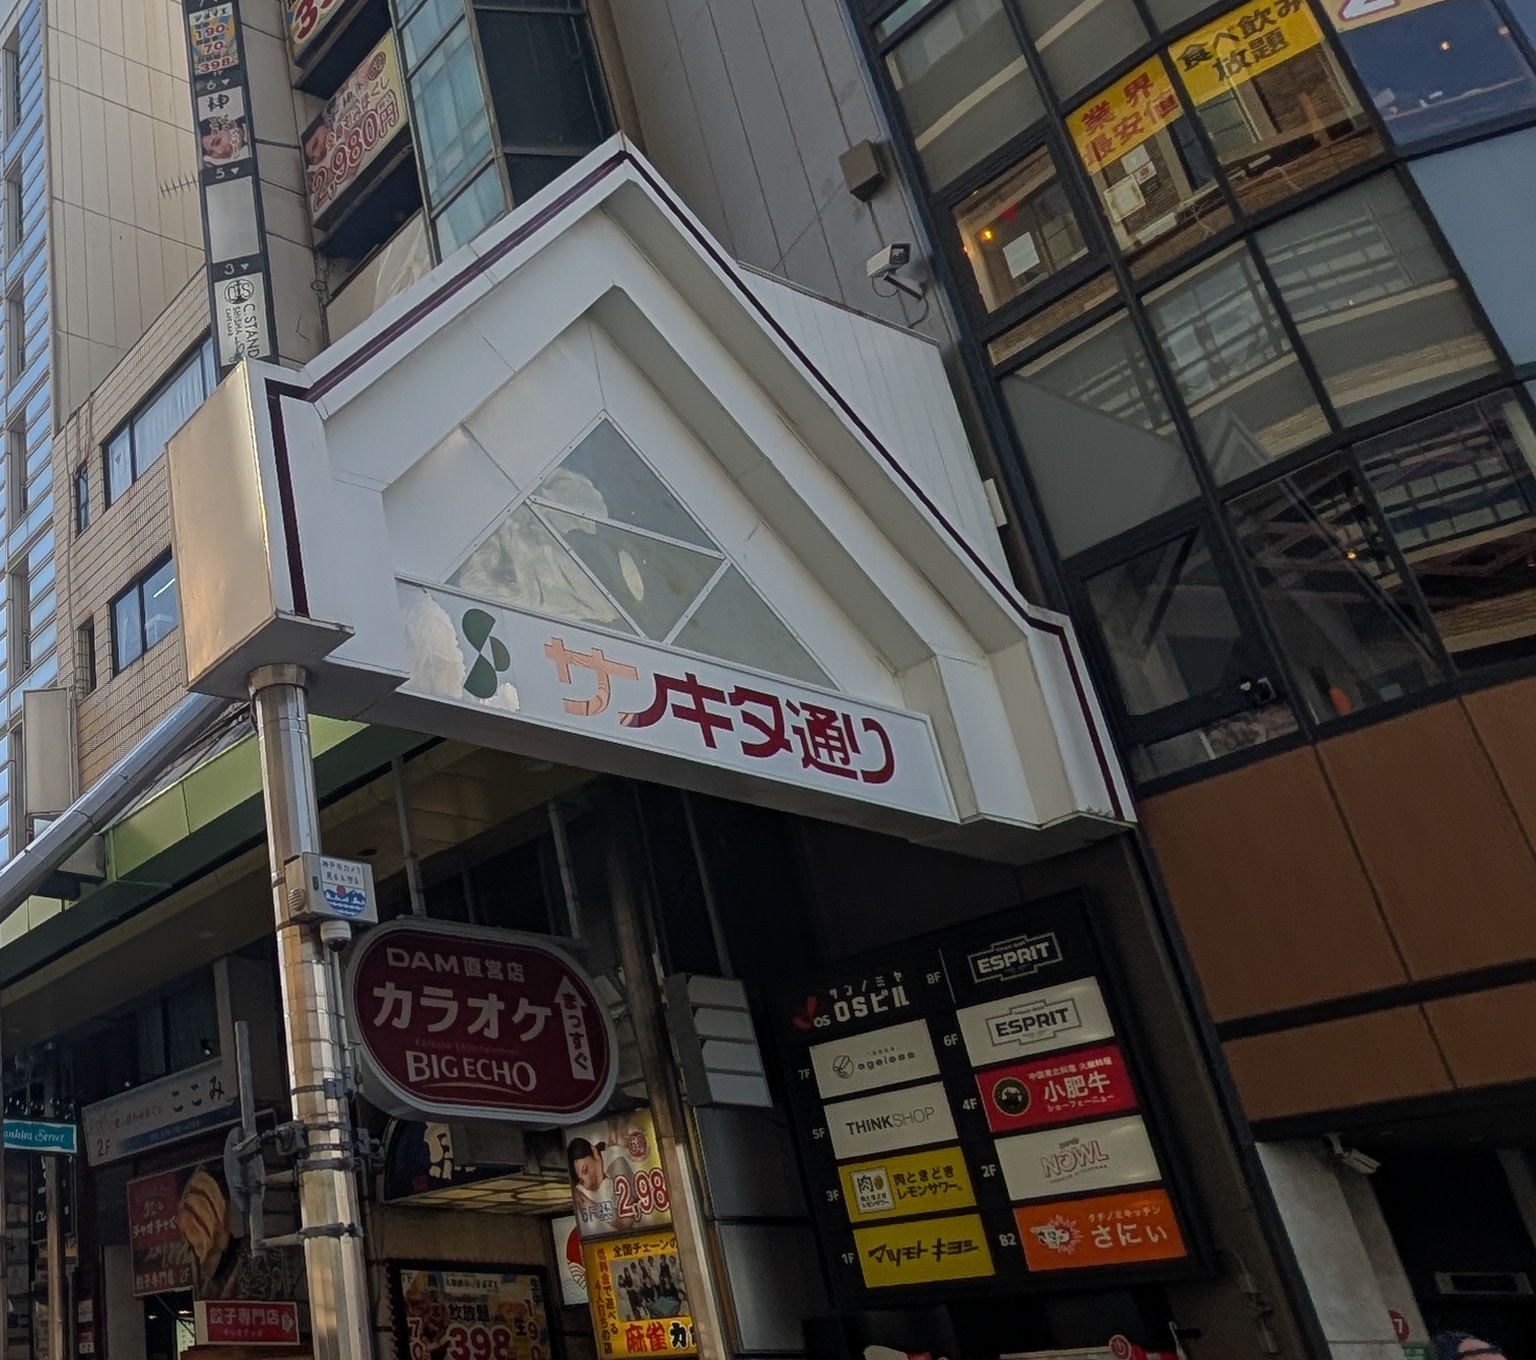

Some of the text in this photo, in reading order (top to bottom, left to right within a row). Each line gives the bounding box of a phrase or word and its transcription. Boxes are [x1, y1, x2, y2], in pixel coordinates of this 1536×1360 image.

[1212, 27, 1289, 82] 放題
[543, 635, 896, 784] サンキタ通り
[976, 941, 1051, 975] ESPRIT
[925, 971, 941, 985] 8F
[372, 981, 553, 1042] カラオケ
[814, 1014, 831, 1028] OS
[995, 1007, 1069, 1038] ESPRIT
[943, 1034, 958, 1047] 6F
[405, 1050, 538, 1093] BIG ECHO
[798, 1069, 811, 1080] 7F
[171, 1075, 225, 1112] ここみ
[1044, 1071, 1111, 1102] 小肥牛
[962, 1098, 978, 1110] 4F
[812, 1128, 826, 1139] 5F
[97, 1139, 111, 1157] 2F
[893, 1165, 954, 1187] 肉ときどき
[981, 1164, 997, 1178] 2F
[856, 1175, 874, 1193] 肉
[614, 1169, 670, 1222] 2,98
[826, 1189, 840, 1202] 3F
[613, 1238, 678, 1258] 全国チェーンの
[868, 1237, 979, 1267] マツモトキヨシ
[842, 1252, 855, 1265] 1F
[209, 1307, 279, 1326] 餃子専門店
